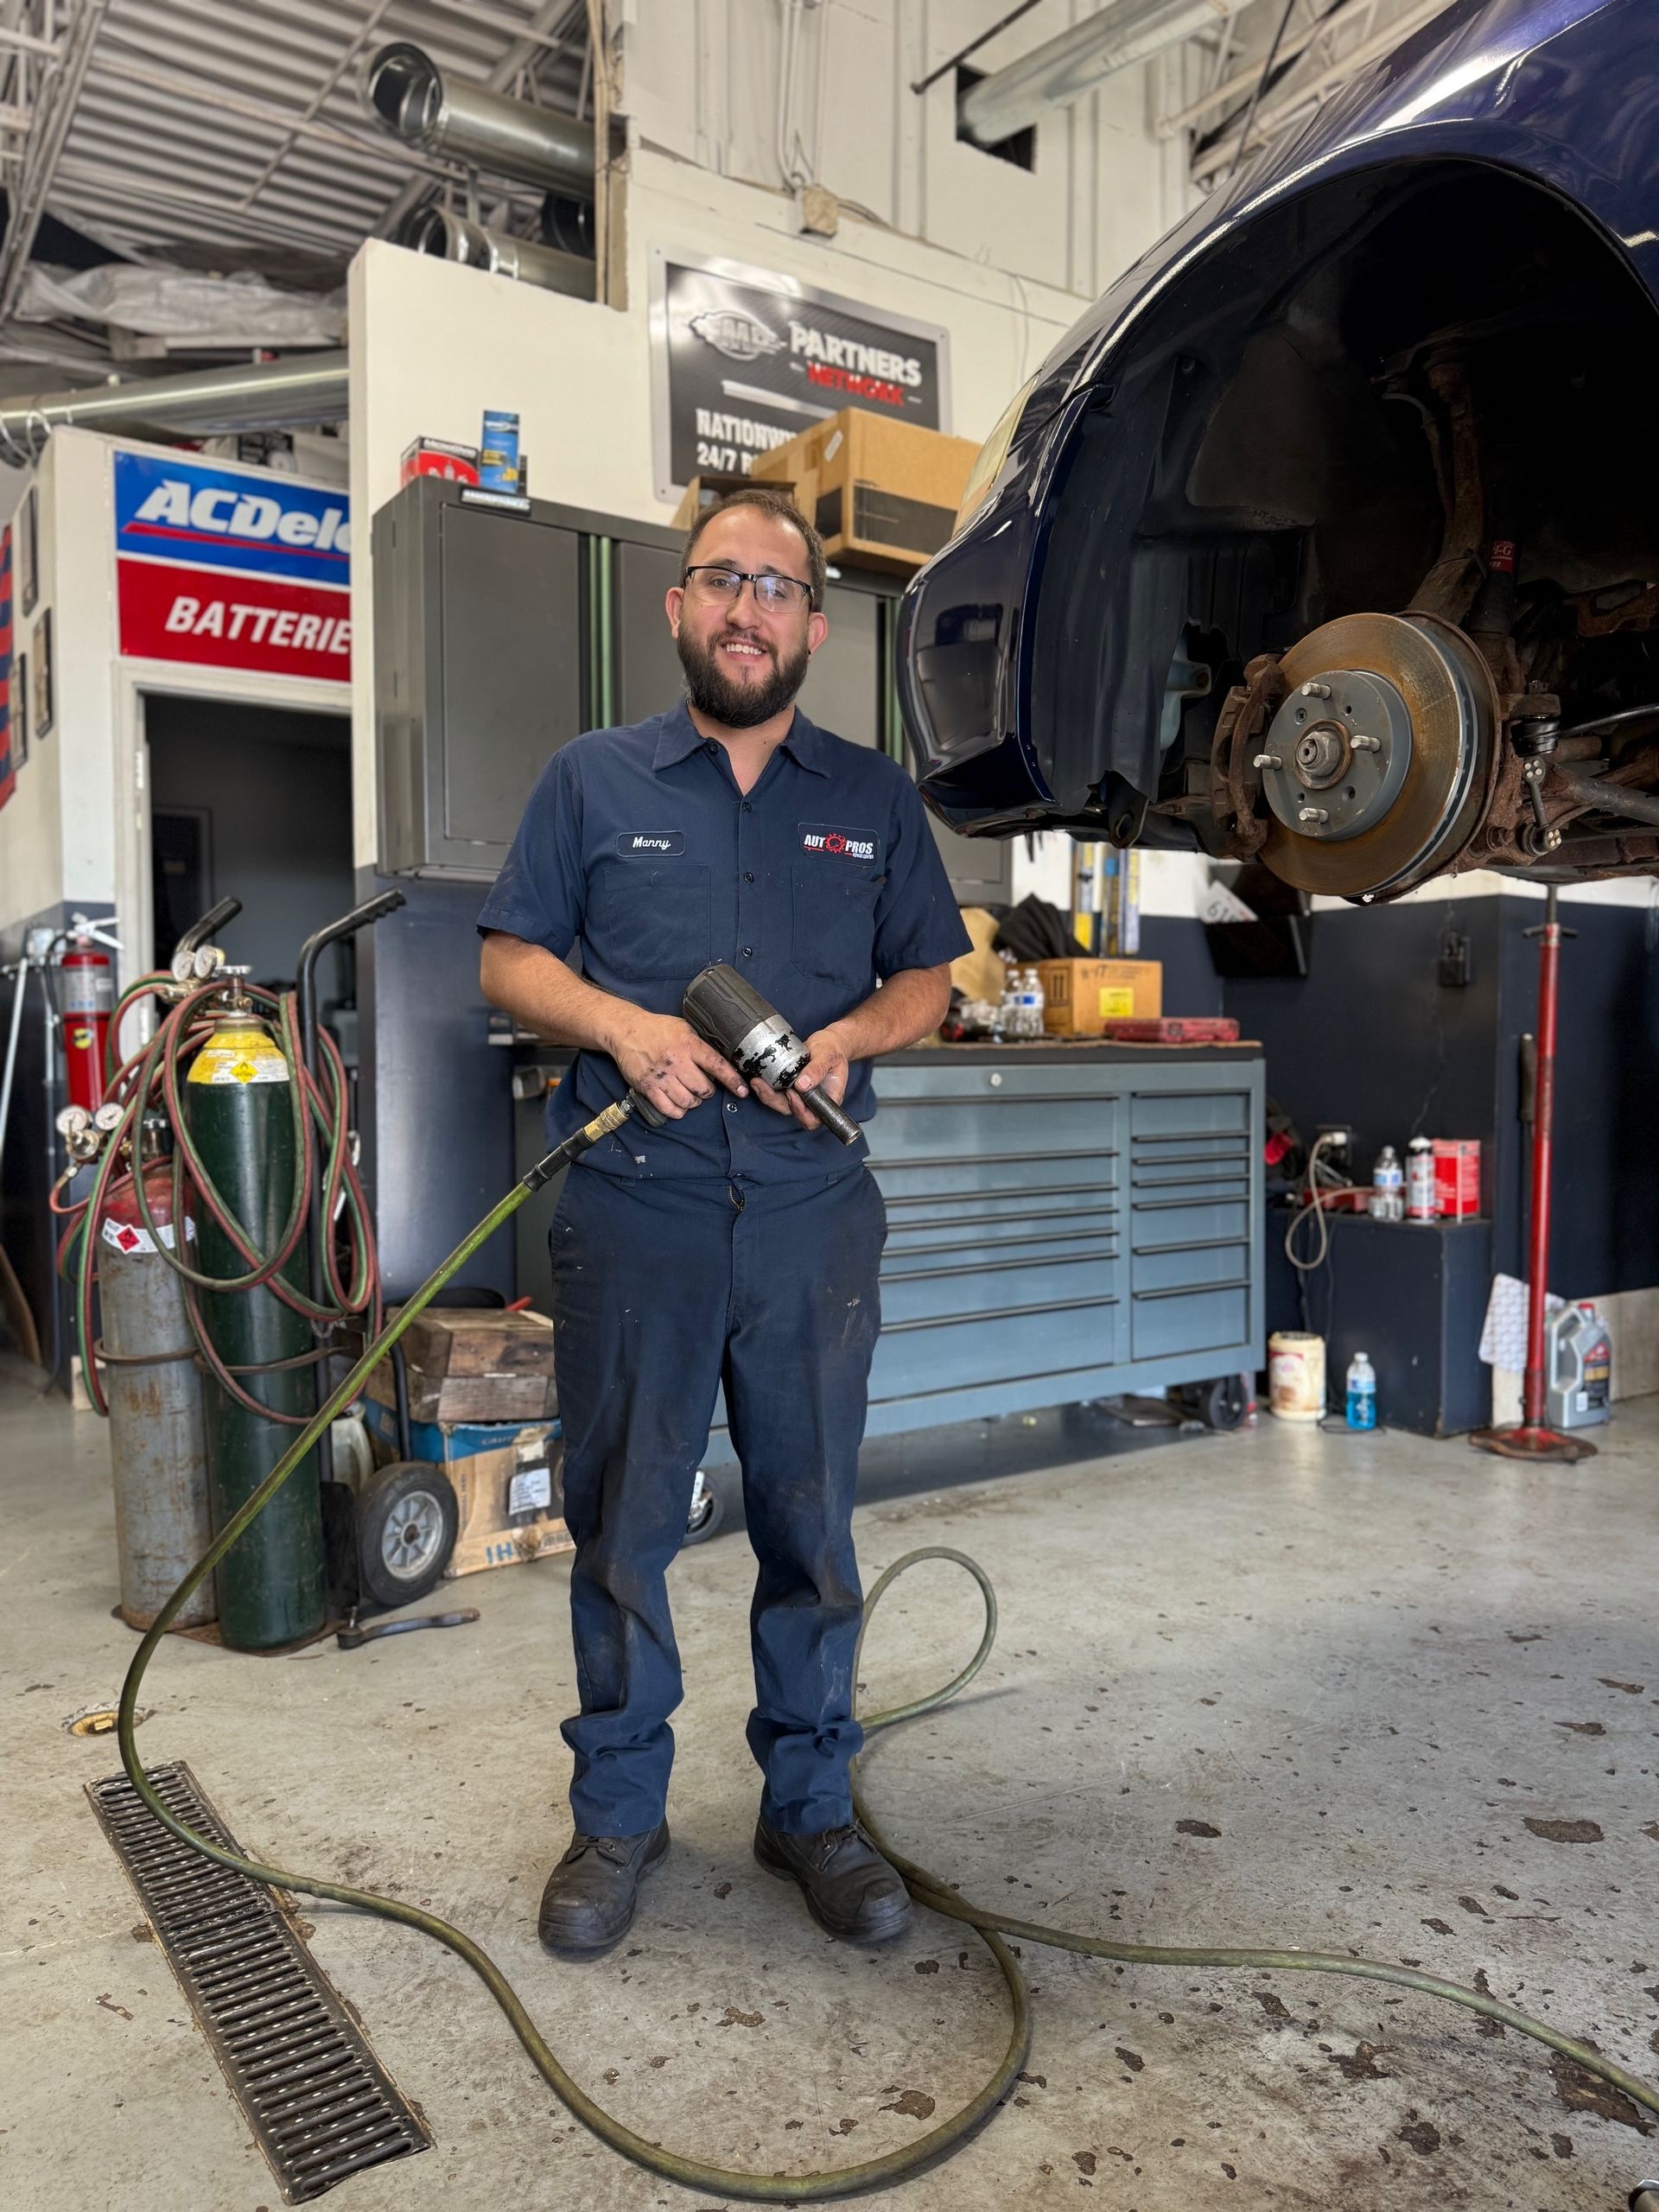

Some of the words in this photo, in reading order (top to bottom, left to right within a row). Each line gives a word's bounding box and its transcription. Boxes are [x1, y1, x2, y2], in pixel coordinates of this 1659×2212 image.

[788, 321, 922, 386] PARTNERS
[806, 359, 904, 406] NETWORK
[696, 442, 737, 472] 24/7
[741, 450, 759, 474] R
[165, 596, 351, 654] BATTERIE
[632, 836, 671, 850] Manny
[845, 840, 874, 855] PROS
